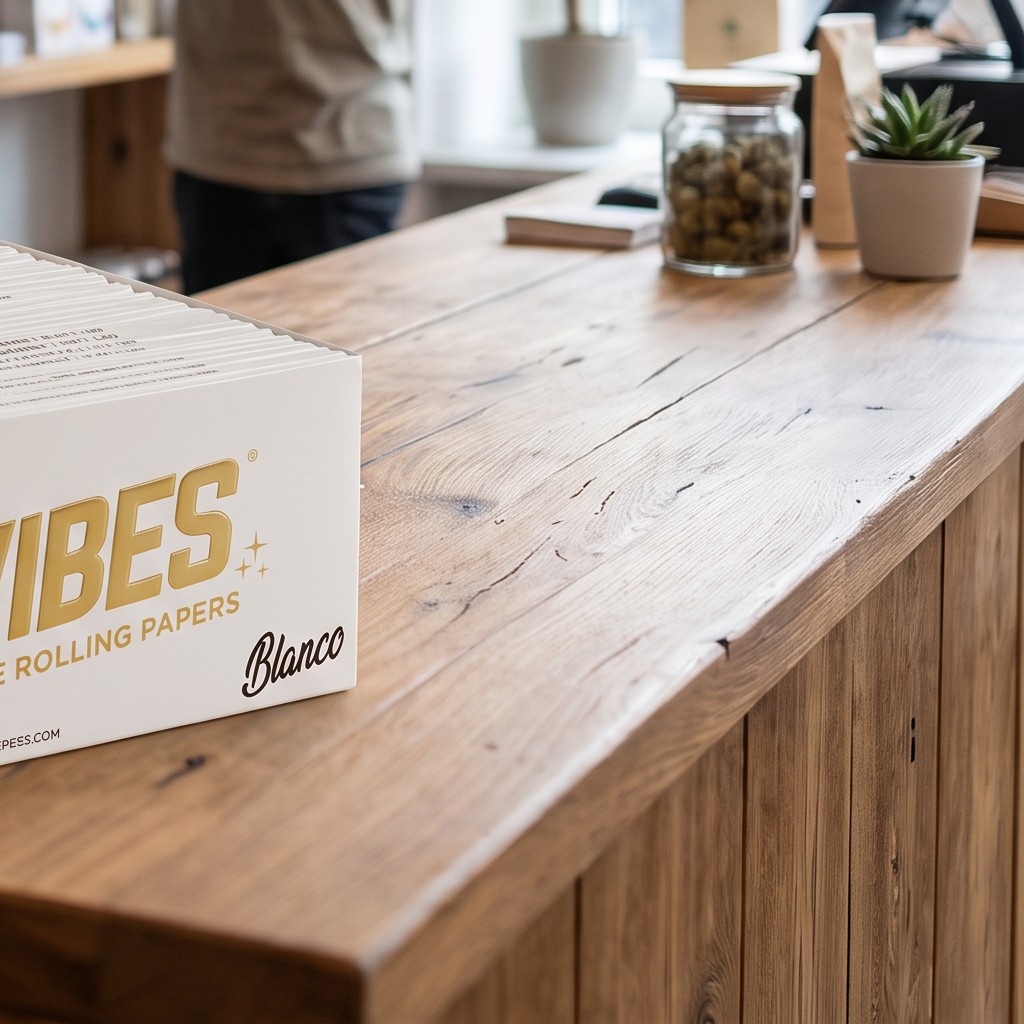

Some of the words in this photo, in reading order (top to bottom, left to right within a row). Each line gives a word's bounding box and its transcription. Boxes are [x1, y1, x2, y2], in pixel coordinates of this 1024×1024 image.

[15, 625, 131, 680] ROLLING
[142, 591, 240, 641] PAPERS
[241, 626, 345, 697] Blanco
